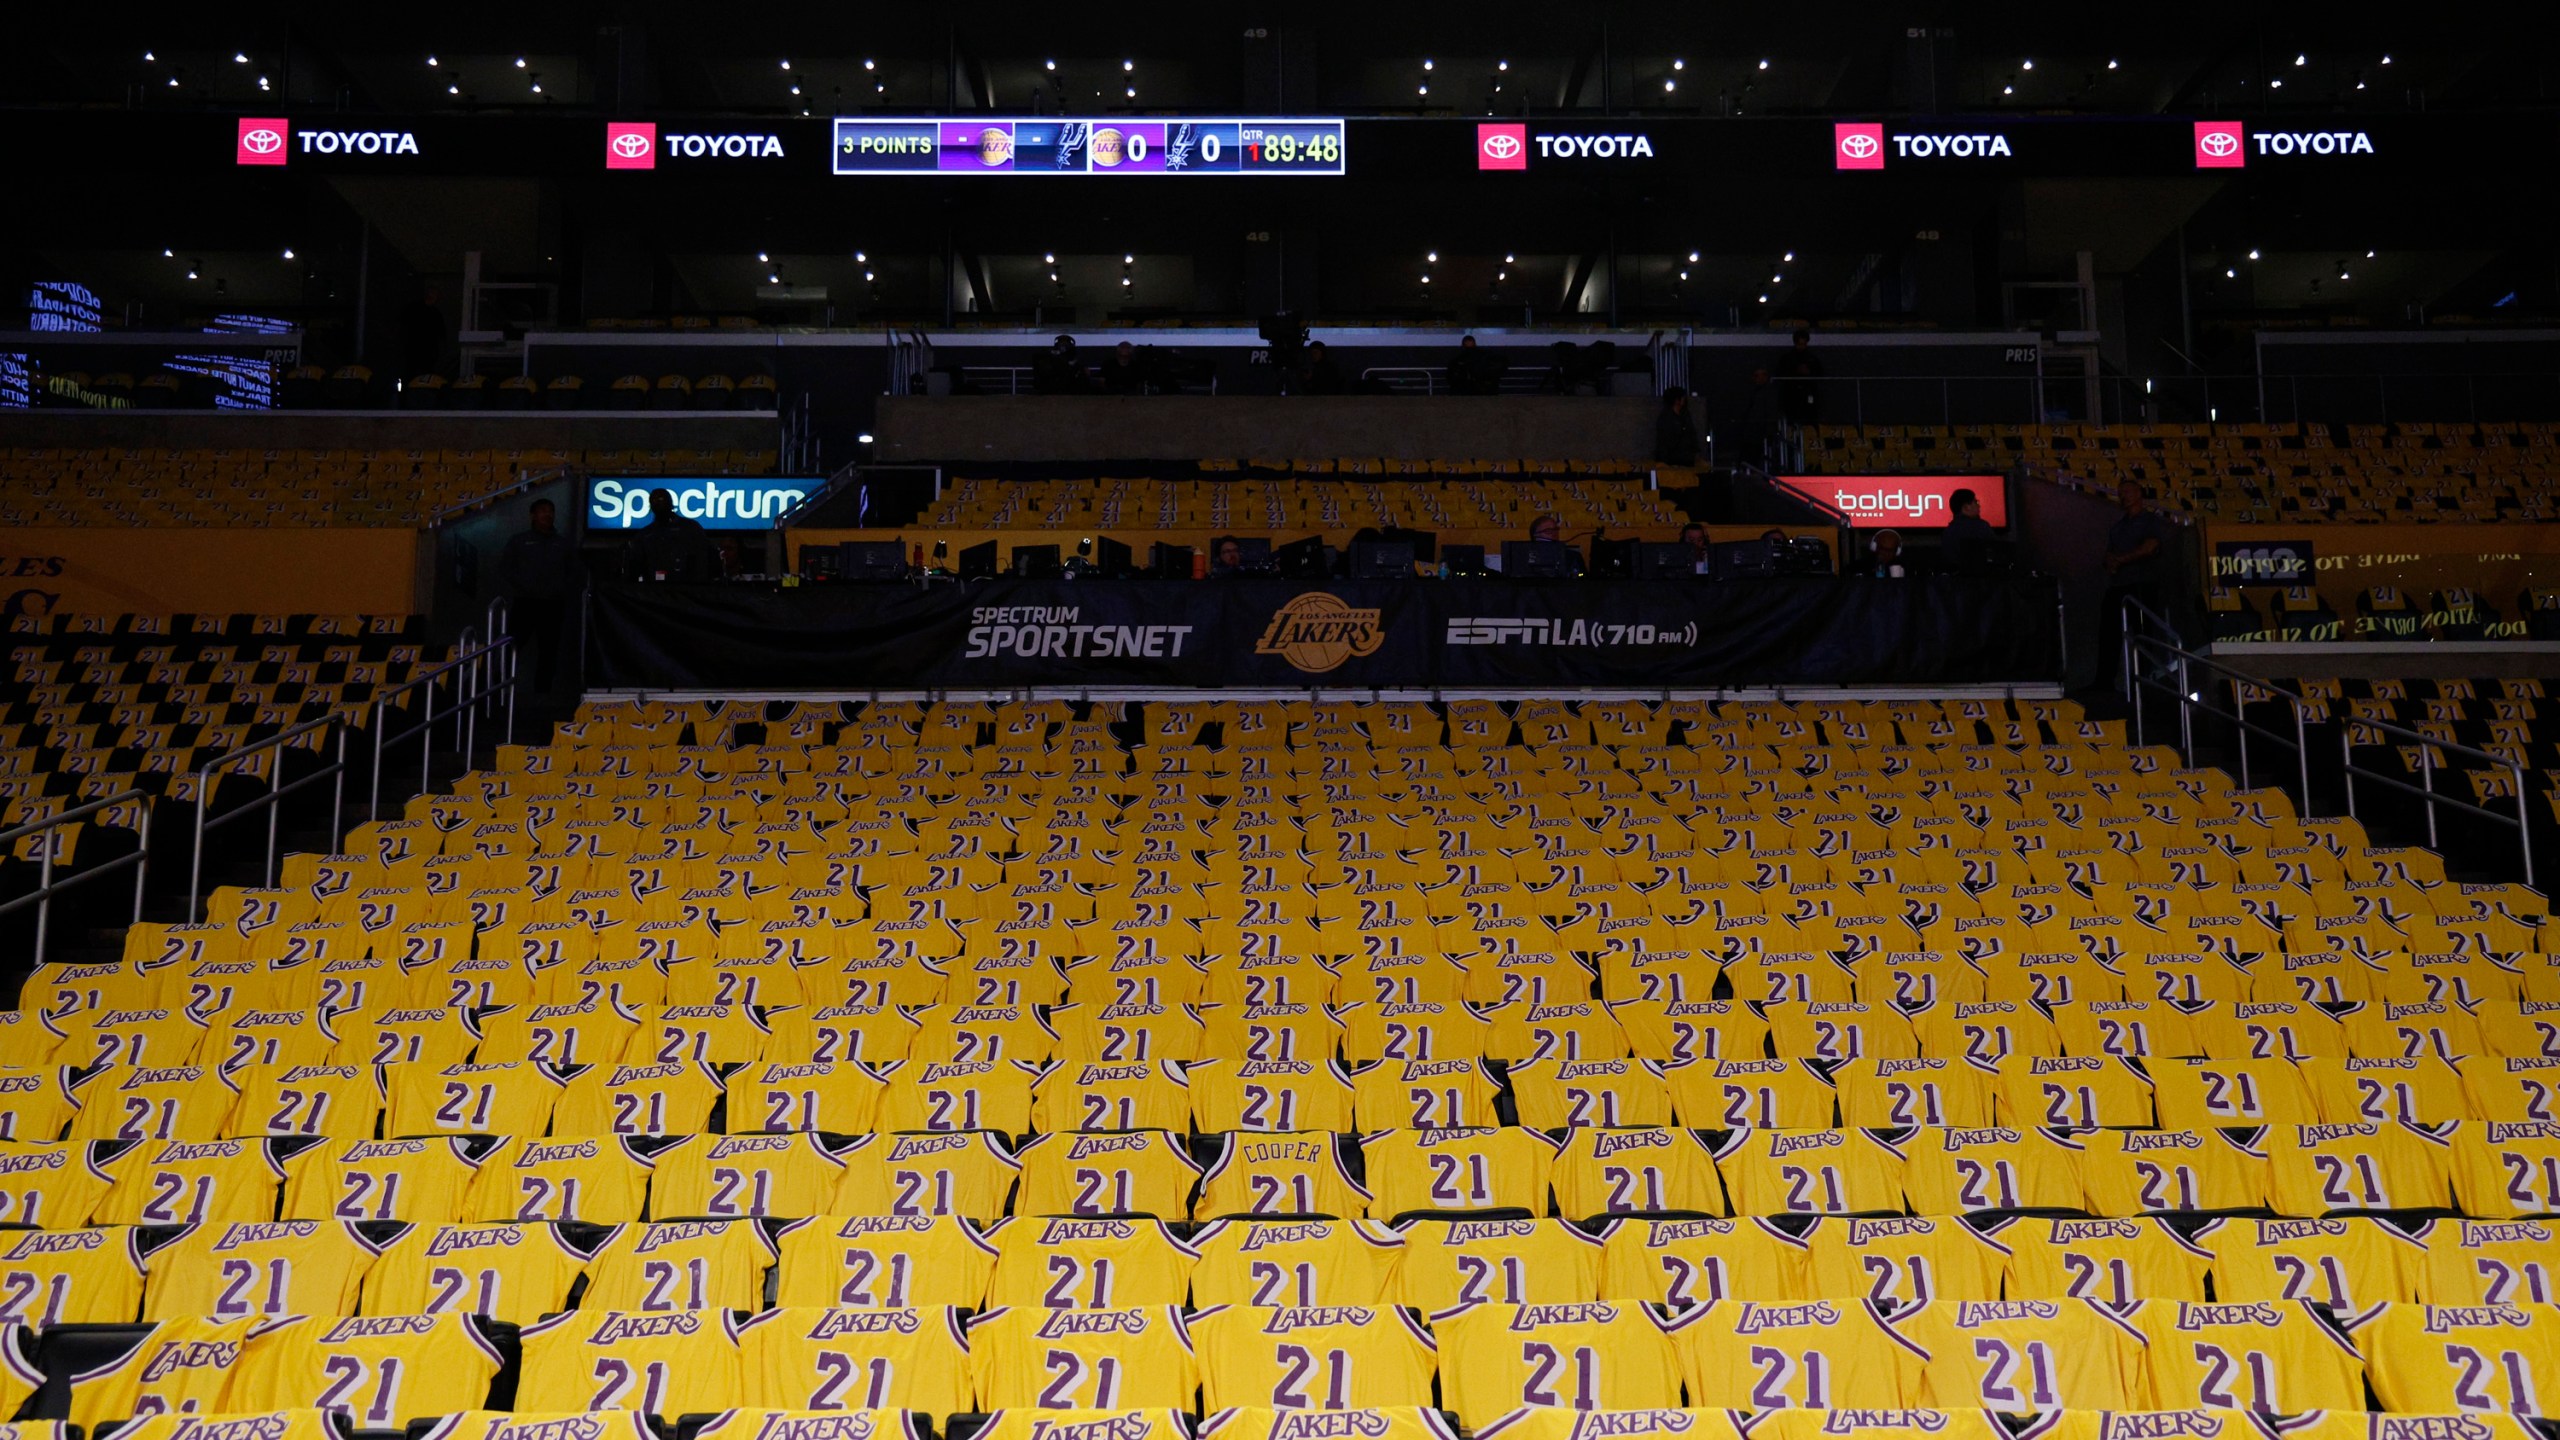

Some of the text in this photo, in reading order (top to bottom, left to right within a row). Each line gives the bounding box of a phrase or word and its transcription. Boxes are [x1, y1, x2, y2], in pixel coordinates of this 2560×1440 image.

[298, 132, 418, 154] TOYOTA
[666, 135, 784, 157] TOYOTA
[843, 136, 932, 153] 3 POINTS
[1127, 134, 1147, 162] 0
[1201, 134, 1221, 162] 0
[1242, 129, 1263, 141] QTR
[1264, 134, 1339, 162] 89:48
[1536, 136, 1653, 157] TOYOTA
[1893, 135, 2011, 156] TOYOTA
[2253, 133, 2373, 154] TOYOTA
[1248, 142, 1259, 162] 1
[264, 349, 296, 365] PR13
[1251, 350, 1271, 363] PR
[2005, 347, 2036, 363] PR15
[1834, 489, 1943, 517] boldyn
[137, 618, 160, 632] 21
[375, 619, 397, 632] 21
[971, 605, 1080, 624] SPECTRUM
[964, 625, 1193, 659] SPORTSNET
[1261, 612, 1378, 652] LAKERS
[1447, 617, 1549, 644] ESPN
[356, 667, 376, 682] 21
[310, 689, 333, 702] 21
[664, 710, 688, 723] 21
[1961, 702, 1987, 718] 21
[2079, 721, 2104, 737] 21
[2352, 725, 2378, 743] 21
[2496, 727, 2523, 743] 21
[1242, 757, 1267, 772] 21
[2479, 779, 2511, 797] 21
[105, 807, 138, 827] 21
[566, 834, 600, 855] 21
[1337, 831, 1370, 851] 21
[2108, 830, 2143, 851] 21
[242, 899, 278, 924] 21
[447, 958, 513, 973] LAKERS
[1630, 952, 1689, 968] LAKERS
[714, 973, 759, 1004] 21
[1640, 973, 1684, 1000] 21
[2423, 974, 2470, 1003] 21
[375, 1007, 446, 1025] LAKERS
[529, 1027, 579, 1060] 21
[1814, 1021, 1864, 1058] 21
[119, 1066, 205, 1091] LAKERS
[1401, 1060, 1473, 1082] LAKERS
[435, 1082, 496, 1129] 21
[2200, 1071, 2263, 1117] 21
[118, 1097, 180, 1139] 21
[1241, 1085, 1297, 1132] 21
[887, 1133, 971, 1161] LAKERS
[1243, 1141, 1321, 1164] COOPER
[2122, 1130, 2202, 1153] LAKERS
[893, 1170, 954, 1215] 21
[1429, 1153, 1493, 1206] 21
[2136, 1161, 2199, 1210] 21
[2314, 1154, 2389, 1209] 21
[1251, 1175, 1316, 1215] 21
[2, 1228, 107, 1260] LAKERS
[213, 1221, 319, 1251] LAKERS
[424, 1224, 526, 1256] LAKERS
[1036, 1219, 1138, 1245] LAKERS
[1442, 1220, 1536, 1245] LAKERS
[1647, 1219, 1736, 1247] LAKERS
[2048, 1218, 2142, 1244] LAKERS
[2460, 1220, 2551, 1248] LAKERS
[215, 1258, 290, 1314] 21
[424, 1268, 500, 1315] 21
[642, 1258, 709, 1310] 21
[840, 1249, 913, 1308] 21
[1043, 1256, 1114, 1308] 21
[1251, 1261, 1312, 1306] 21
[1458, 1255, 1528, 1304] 21
[1662, 1256, 1729, 1313] 21
[1863, 1256, 1933, 1308] 21
[2064, 1254, 2134, 1309] 21
[2274, 1256, 2355, 1319] 21
[2477, 1258, 2553, 1305] 21
[0, 1272, 71, 1334] 21
[1508, 1302, 1619, 1331] LAKERS
[1954, 1302, 2059, 1328] LAKERS
[2175, 1301, 2284, 1331] LAKERS
[319, 1315, 439, 1343] LAKERS
[586, 1310, 703, 1345] LAKERS
[805, 1308, 924, 1340] LAKERS
[1034, 1308, 1151, 1339] LAKERS
[1262, 1306, 1376, 1333] LAKERS
[1734, 1302, 1842, 1334] LAKERS
[2424, 1305, 2531, 1333] LAKERS
[590, 1358, 668, 1412] 21
[808, 1350, 893, 1410] 21
[1037, 1349, 1122, 1409] 21
[1273, 1344, 1353, 1409] 21
[1524, 1342, 1599, 1410] 21
[1751, 1345, 1830, 1408] 21
[1974, 1338, 2055, 1412] 21
[2194, 1342, 2278, 1412] 21
[2446, 1344, 2534, 1414] 21
[315, 1356, 404, 1427] 21
[171, 1411, 290, 1440] LAKERS
[1268, 1409, 1390, 1440] LAKERS
[1822, 1410, 1948, 1436] LAKERS
[2367, 1412, 2494, 1440] LAKERS
